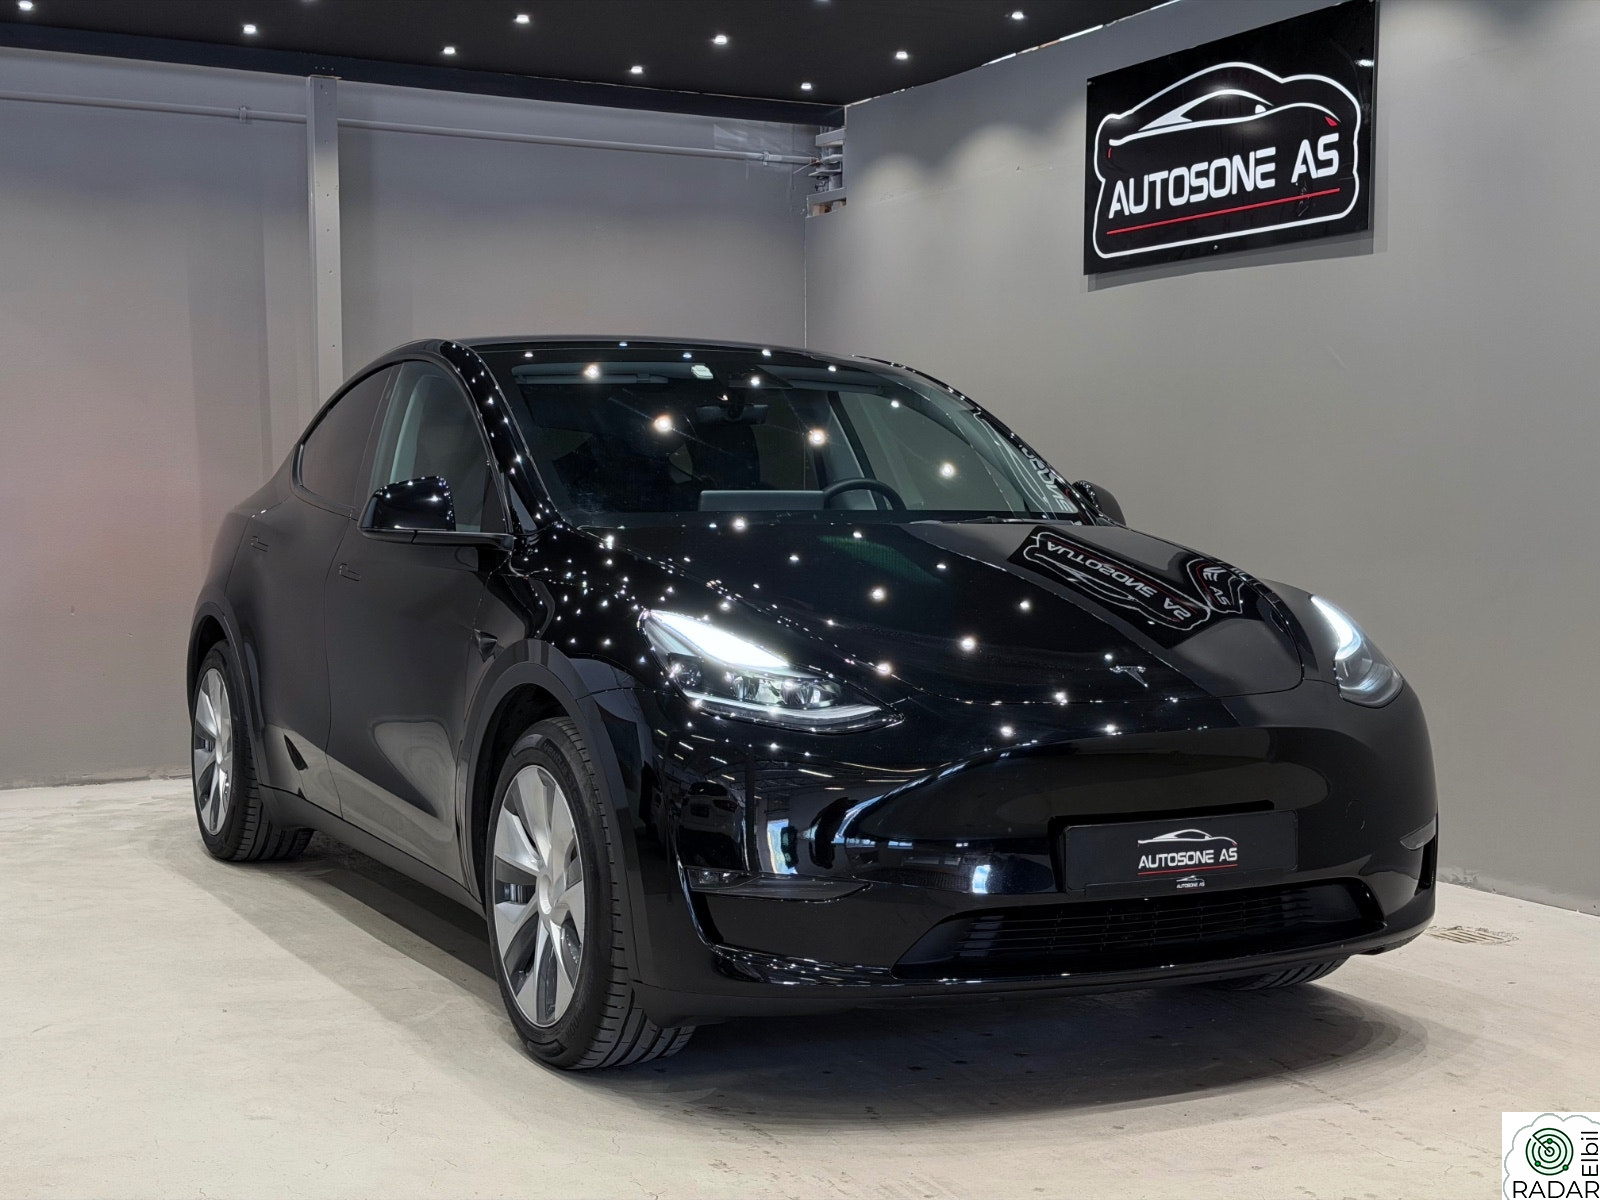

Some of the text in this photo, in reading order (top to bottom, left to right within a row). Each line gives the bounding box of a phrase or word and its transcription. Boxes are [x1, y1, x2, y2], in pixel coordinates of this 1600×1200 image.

[1108, 132, 1339, 219] AUTOSONE AS
[1138, 847, 1238, 869] AUTOSONE AS
